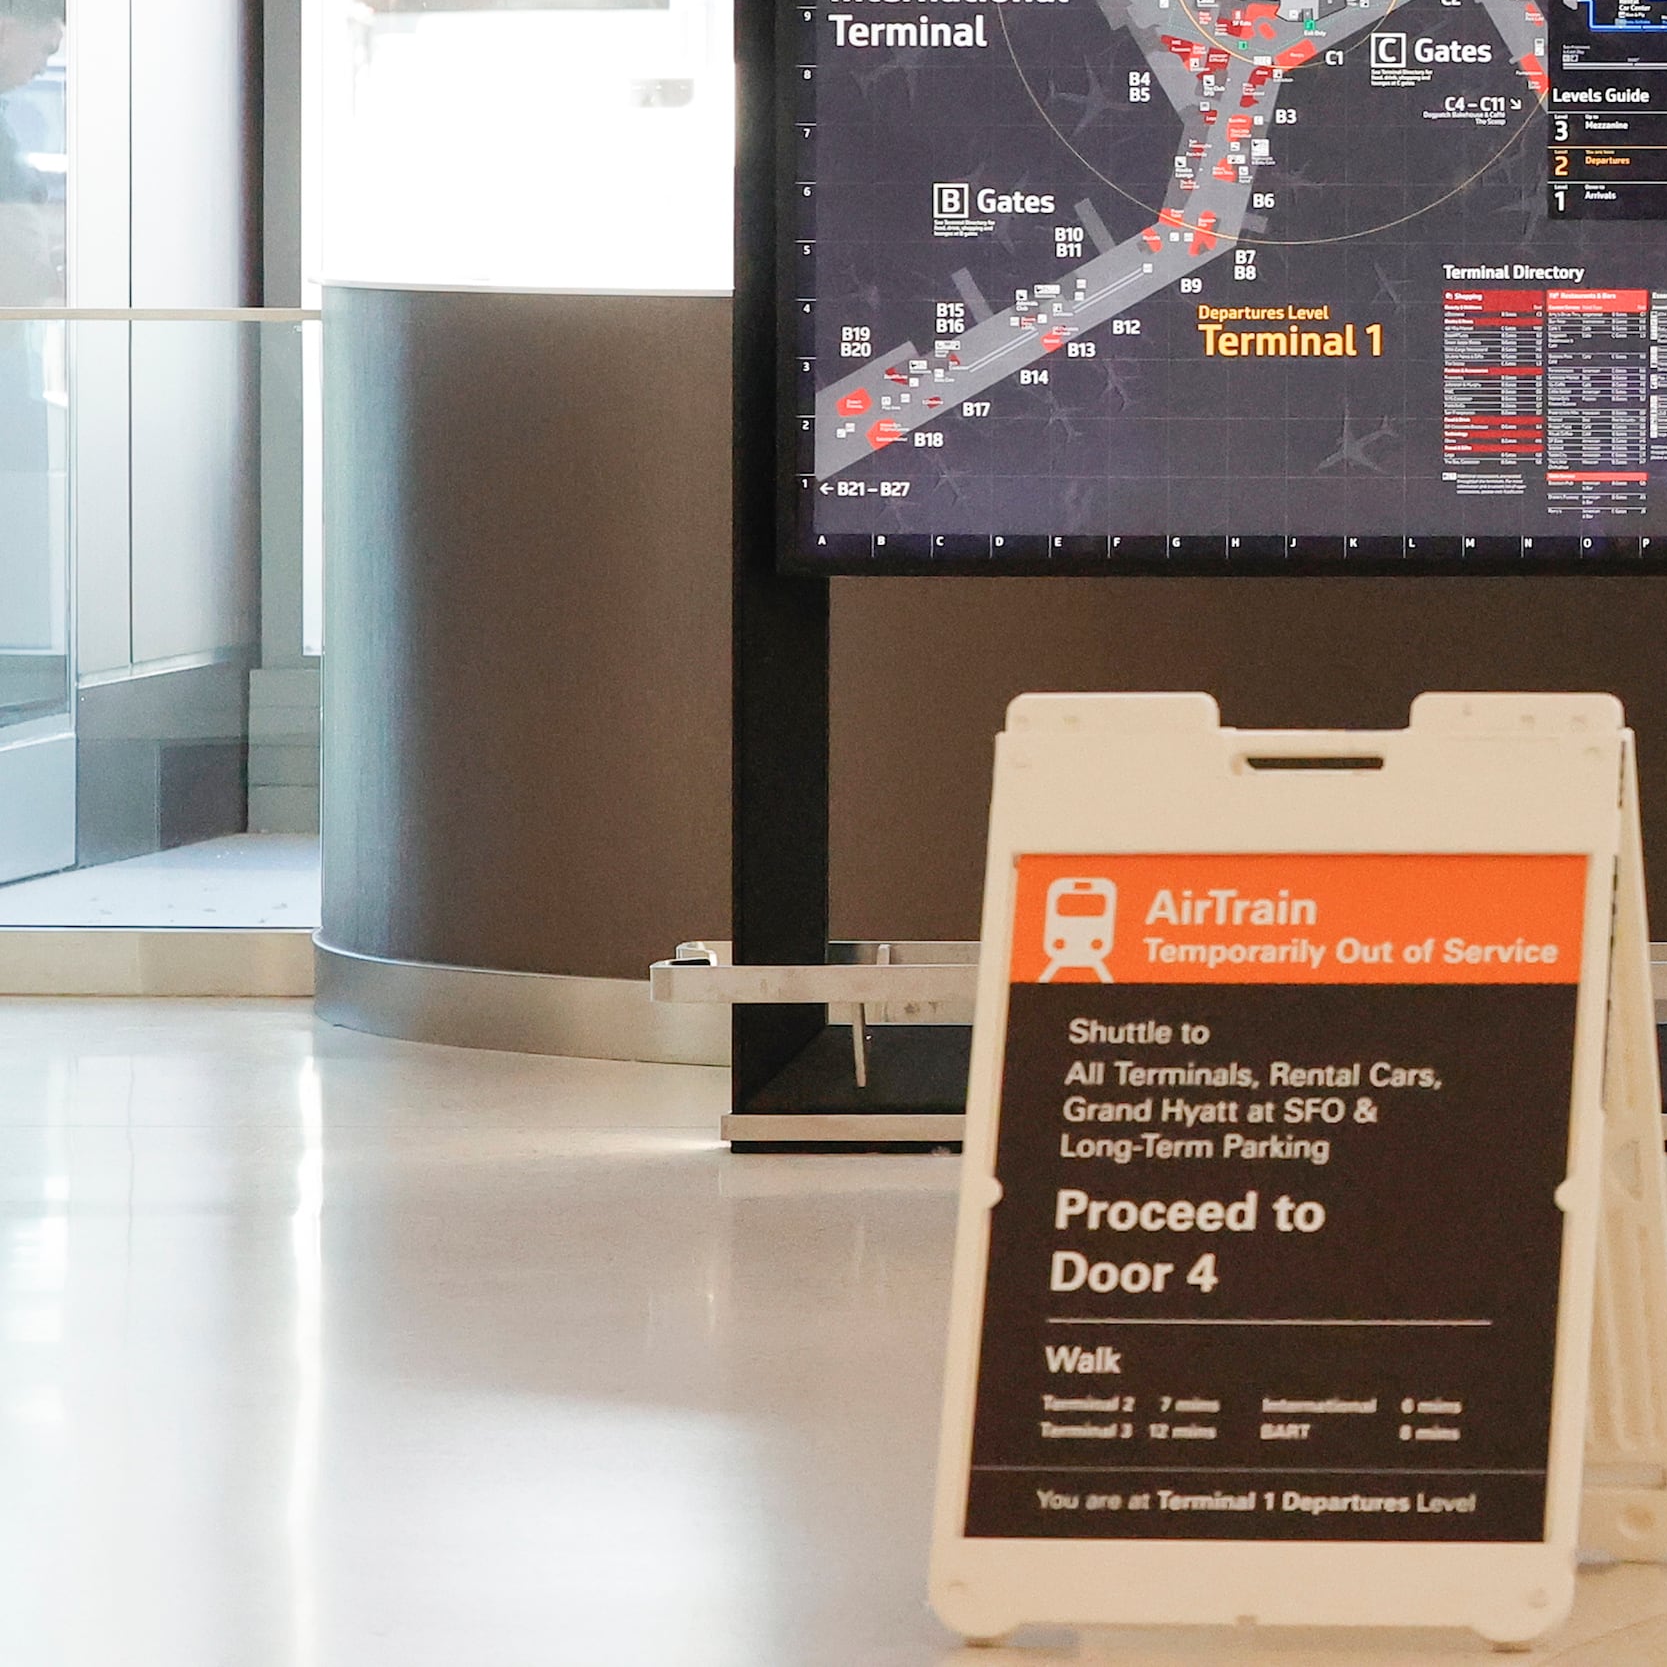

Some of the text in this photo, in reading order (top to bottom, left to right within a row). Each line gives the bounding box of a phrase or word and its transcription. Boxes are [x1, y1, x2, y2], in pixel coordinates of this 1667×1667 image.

[828, 14, 988, 47] Terminal
[1414, 37, 1492, 63] Gates
[1552, 87, 1650, 103] Levels Guide
[977, 188, 1055, 214] Gates
[1442, 264, 1585, 283] Terminal Directory
[1198, 304, 1330, 323] Departures Level
[1197, 323, 1381, 356] Terminal 1
[1144, 888, 1318, 926] AirTrain
[1142, 936, 1559, 969] Temporarily Out of Service
[1068, 1017, 1210, 1045] Shuttle to
[1063, 1060, 1443, 1090] All Terminals, Rental Cars,
[1062, 1095, 1378, 1128] Grand Hyatt at SFO &
[1060, 1132, 1330, 1165] Long-Term Parking
[1055, 1189, 1326, 1233] Proceed to
[1050, 1250, 1219, 1293] Door 4
[1045, 1345, 1122, 1374] Walk
[1036, 1489, 1477, 1516] You are at Terminal 1 Departures Level
